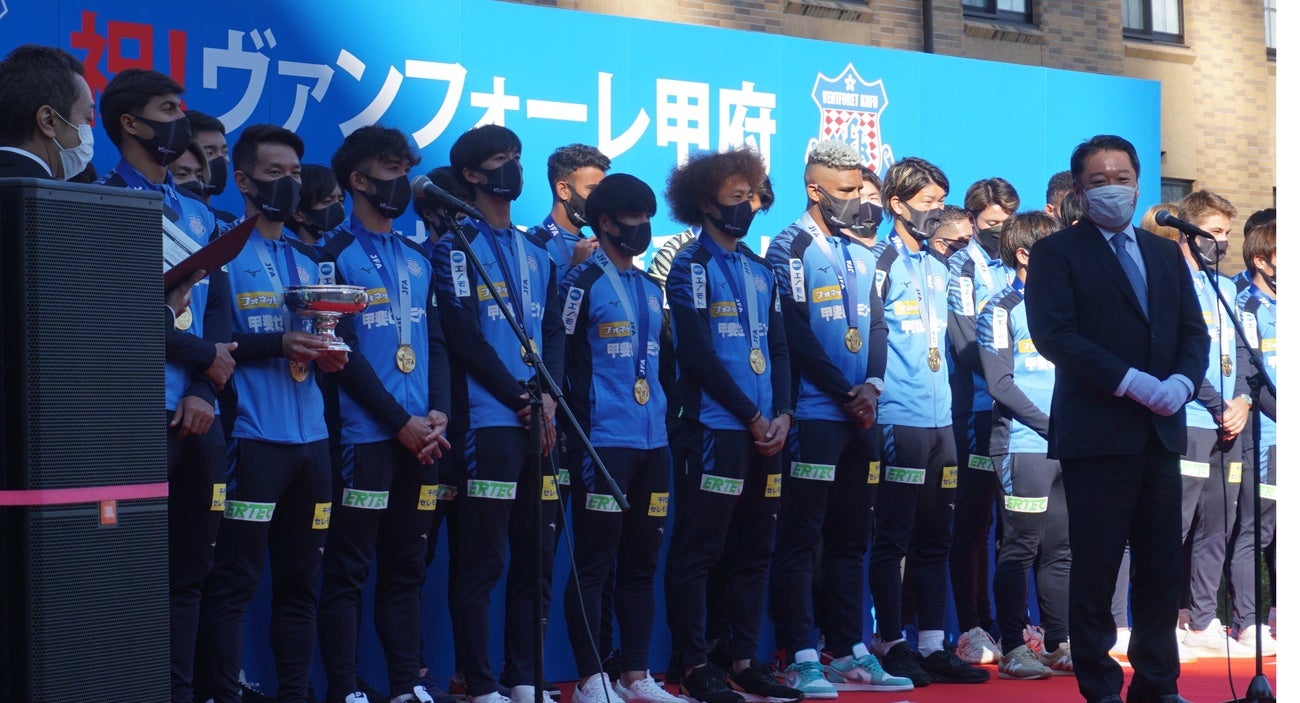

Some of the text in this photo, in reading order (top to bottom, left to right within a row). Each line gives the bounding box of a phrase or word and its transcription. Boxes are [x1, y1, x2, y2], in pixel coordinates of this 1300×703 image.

[547, 223, 560, 236] JFA
[370, 254, 382, 270] JFA
[596, 253, 609, 267] JFA
[265, 262, 277, 278] JFA
[401, 279, 409, 295] JFA
